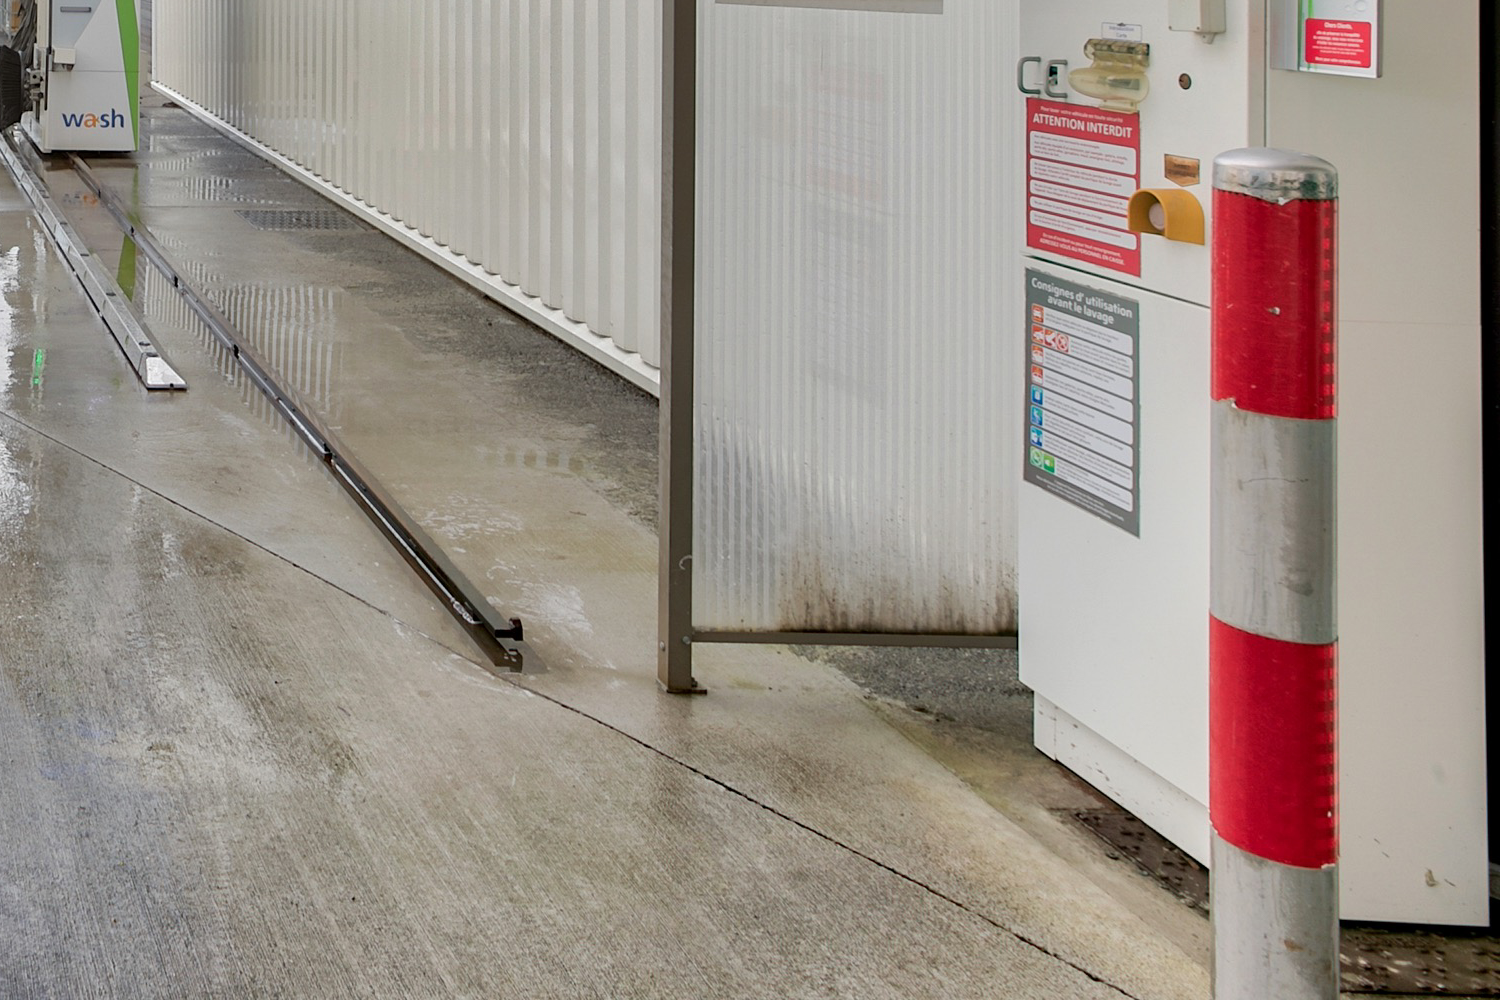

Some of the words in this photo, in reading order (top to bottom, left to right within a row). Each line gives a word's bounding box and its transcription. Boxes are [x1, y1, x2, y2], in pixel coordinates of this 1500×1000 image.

[62, 108, 124, 128] wash
[1032, 112, 1085, 131] ATTENTION
[1086, 122, 1133, 139] INTERDIT
[1031, 278, 1074, 299] Consignes
[1076, 292, 1084, 302] d'
[1086, 296, 1133, 318] utilisation
[1048, 296, 1073, 310] avant
[1074, 302, 1083, 314] le
[1084, 305, 1115, 325] lavage
